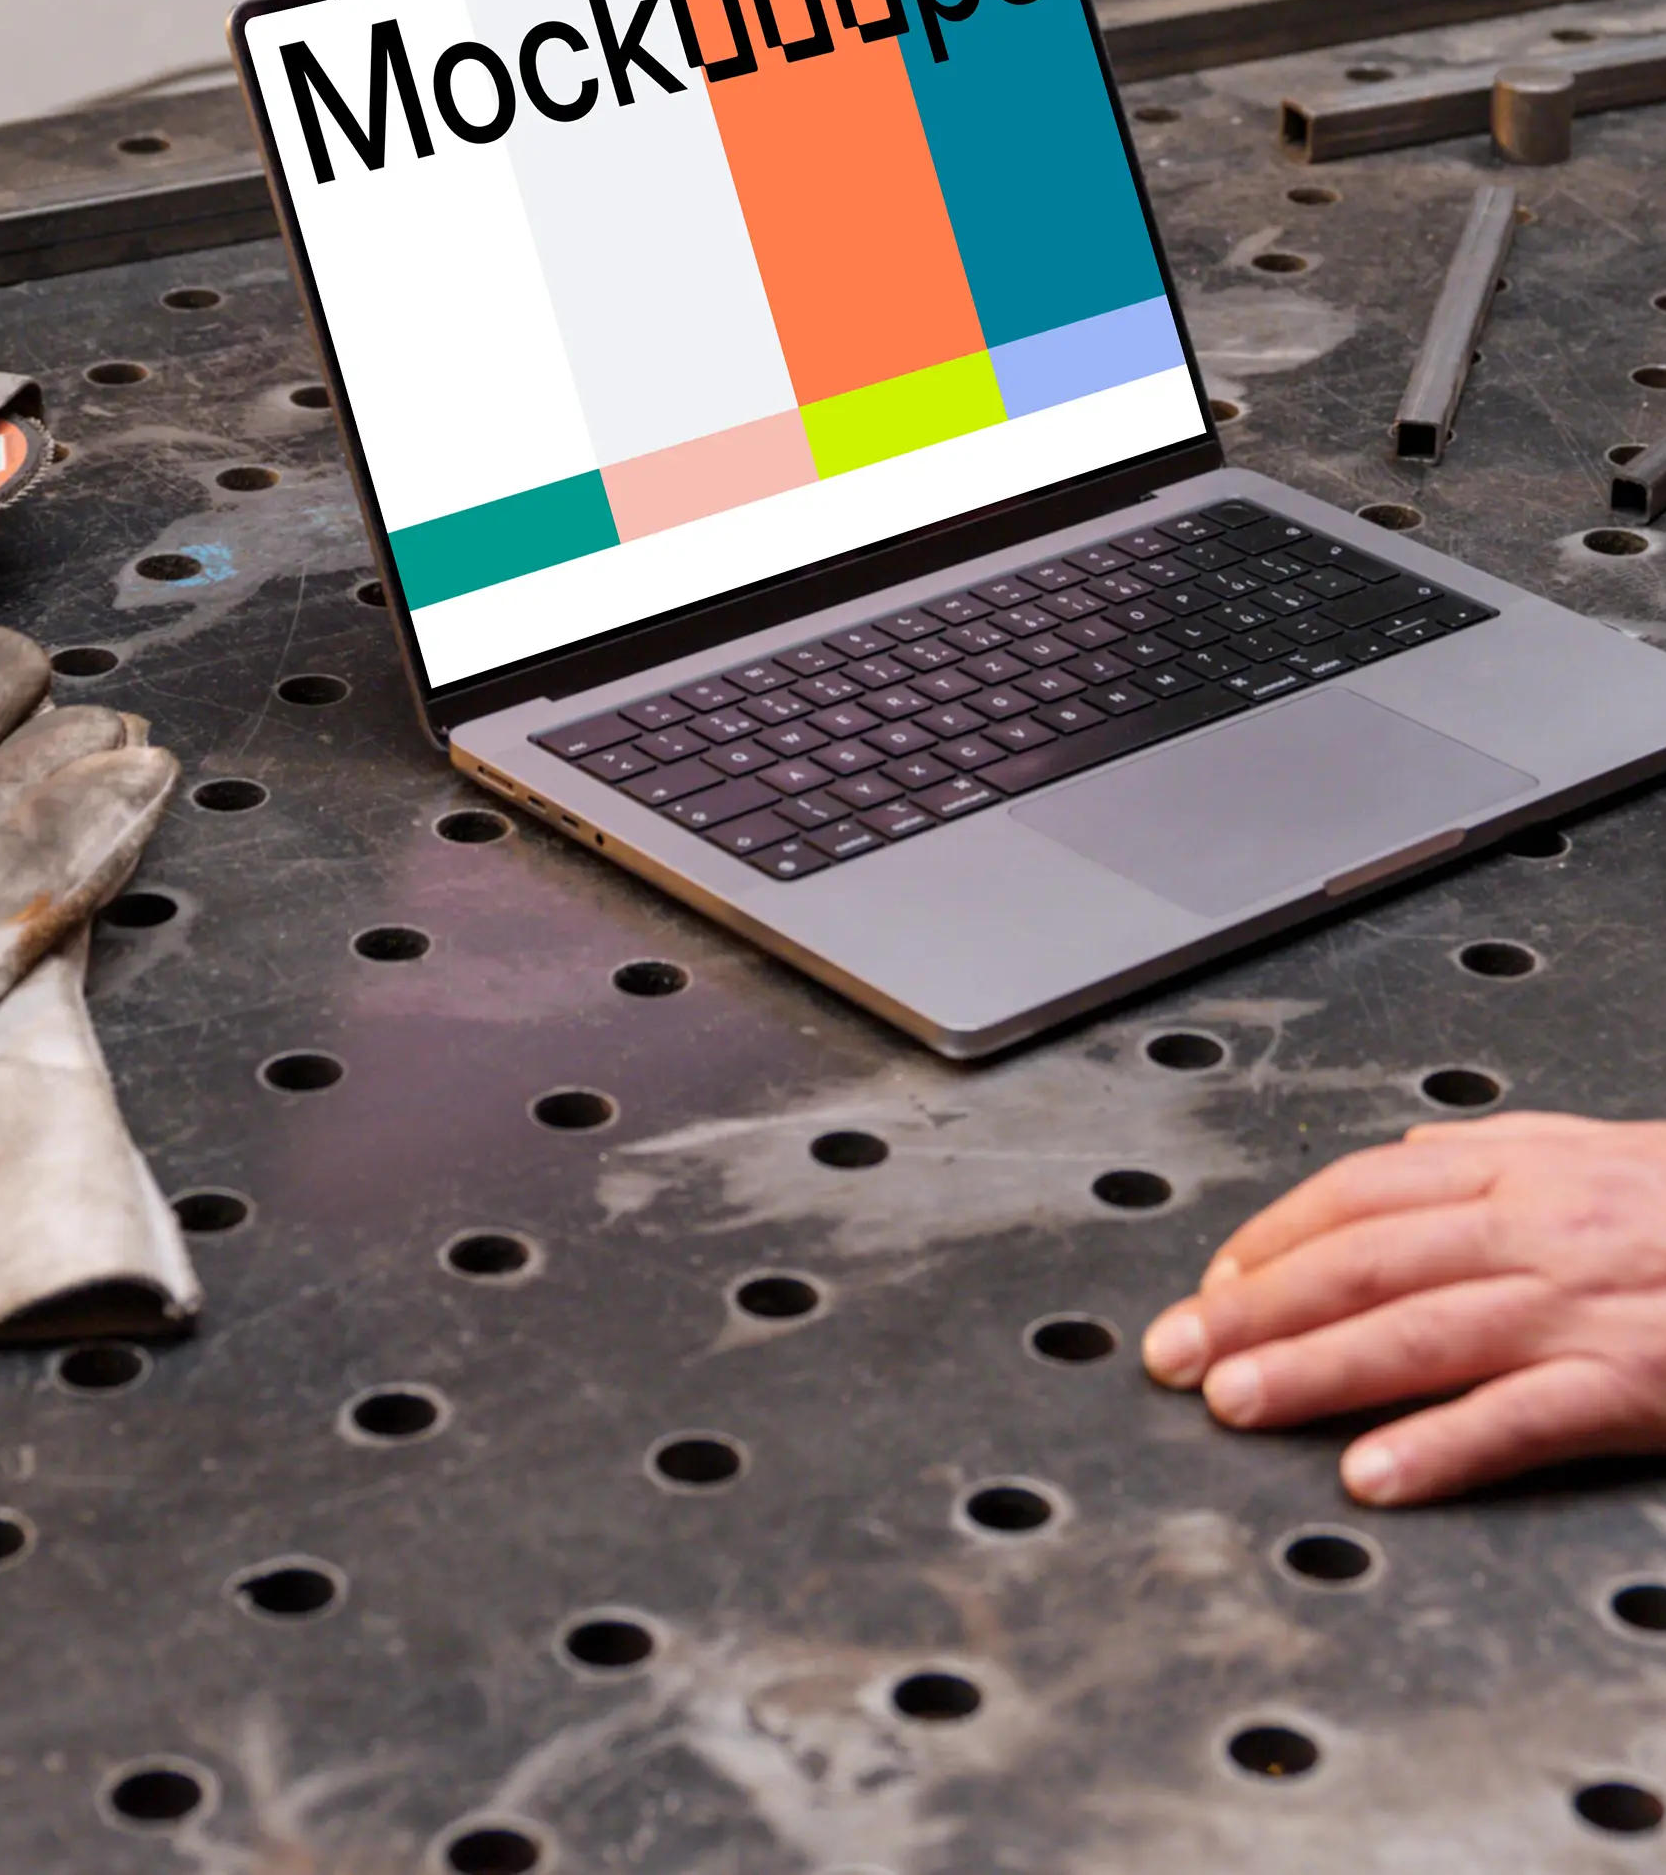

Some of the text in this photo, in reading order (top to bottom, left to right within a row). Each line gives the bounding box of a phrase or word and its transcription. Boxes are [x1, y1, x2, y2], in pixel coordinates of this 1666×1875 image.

[1175, 594, 1189, 604] P
[1184, 628, 1202, 637] L
[1033, 644, 1051, 655] U
[1137, 644, 1155, 655] K
[985, 661, 1003, 672] Z
[935, 679, 950, 689] T
[1040, 679, 1058, 690] H
[1155, 674, 1176, 686] M
[886, 696, 903, 707] R
[1108, 692, 1127, 703] N
[835, 714, 852, 725] E
[780, 732, 801, 744] W
[960, 746, 977, 757] C
[789, 770, 805, 781] A
[908, 764, 927, 776] X
[856, 783, 871, 795] Y
